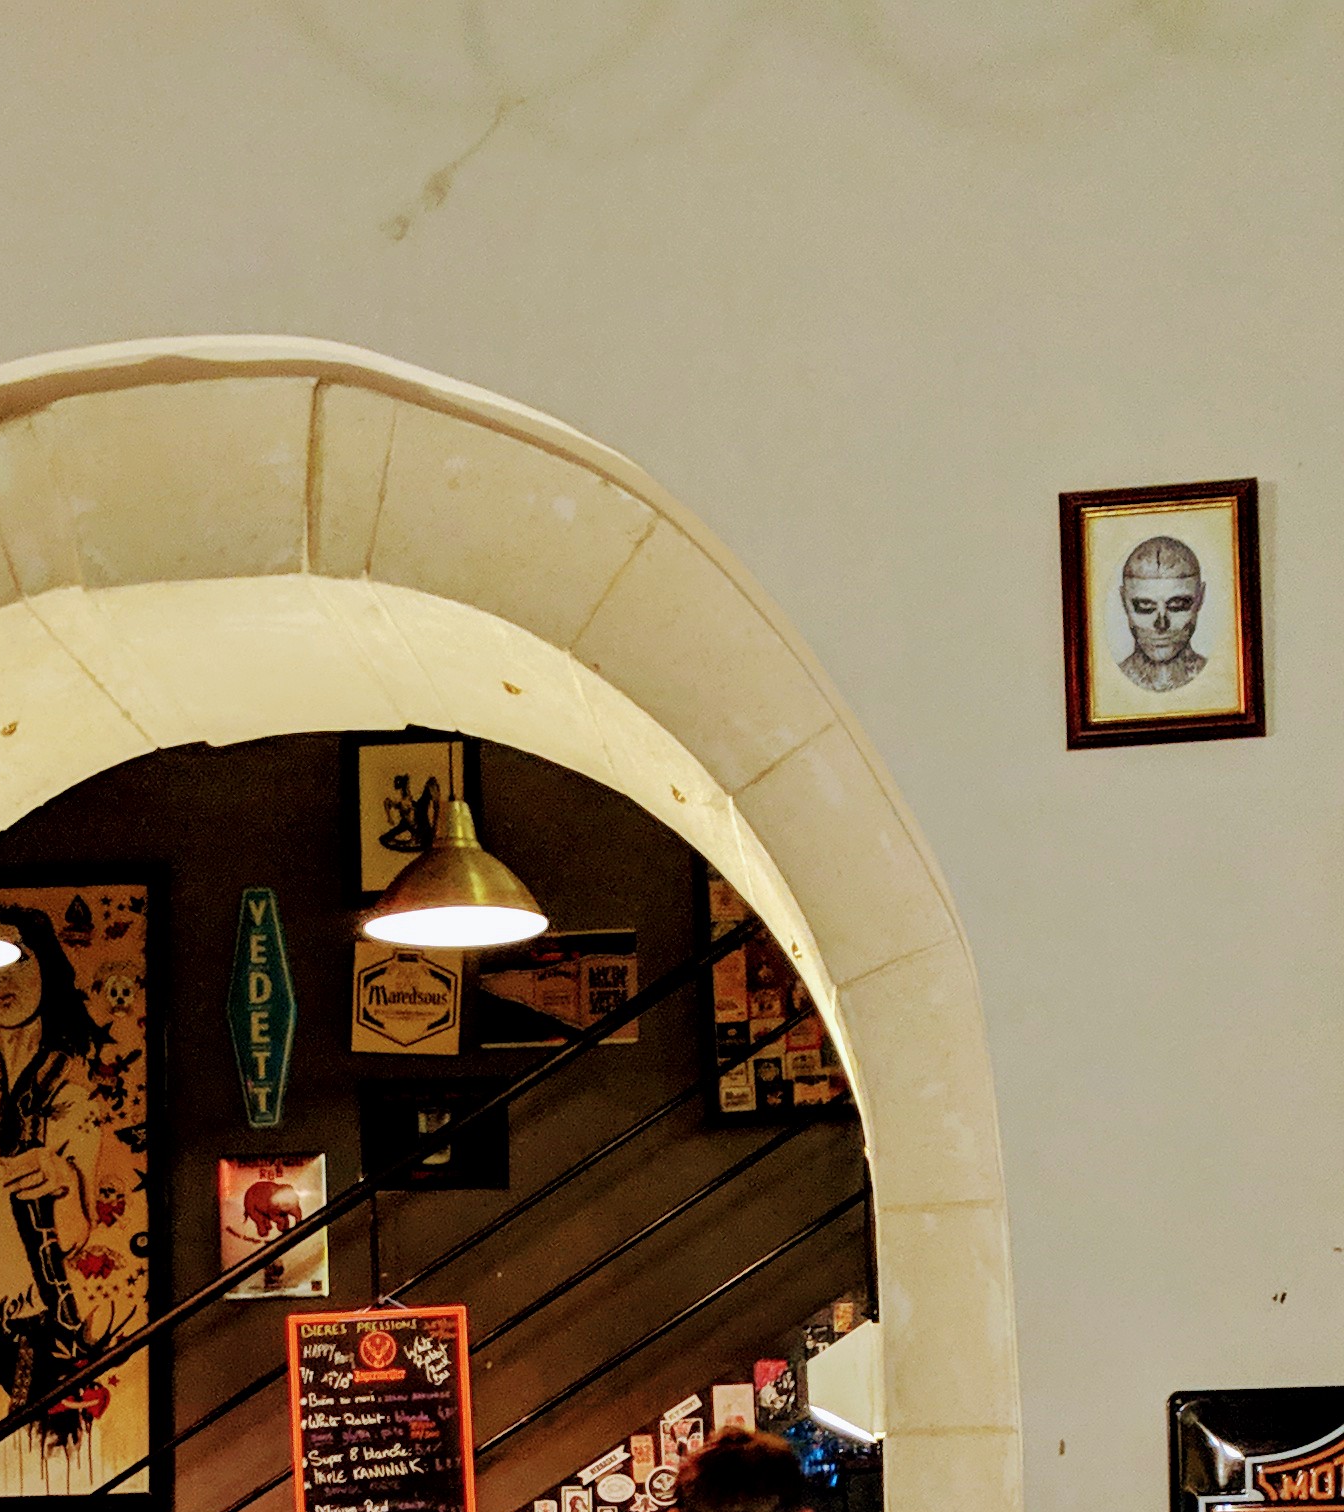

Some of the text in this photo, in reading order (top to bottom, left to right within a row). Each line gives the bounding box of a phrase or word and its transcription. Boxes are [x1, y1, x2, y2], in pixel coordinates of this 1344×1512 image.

[248, 898, 273, 1113] VEDETT
[368, 985, 448, 1006] Maredsous
[308, 1413, 342, 1429] White
[308, 1450, 344, 1470] Super
[349, 1446, 359, 1461] 8
